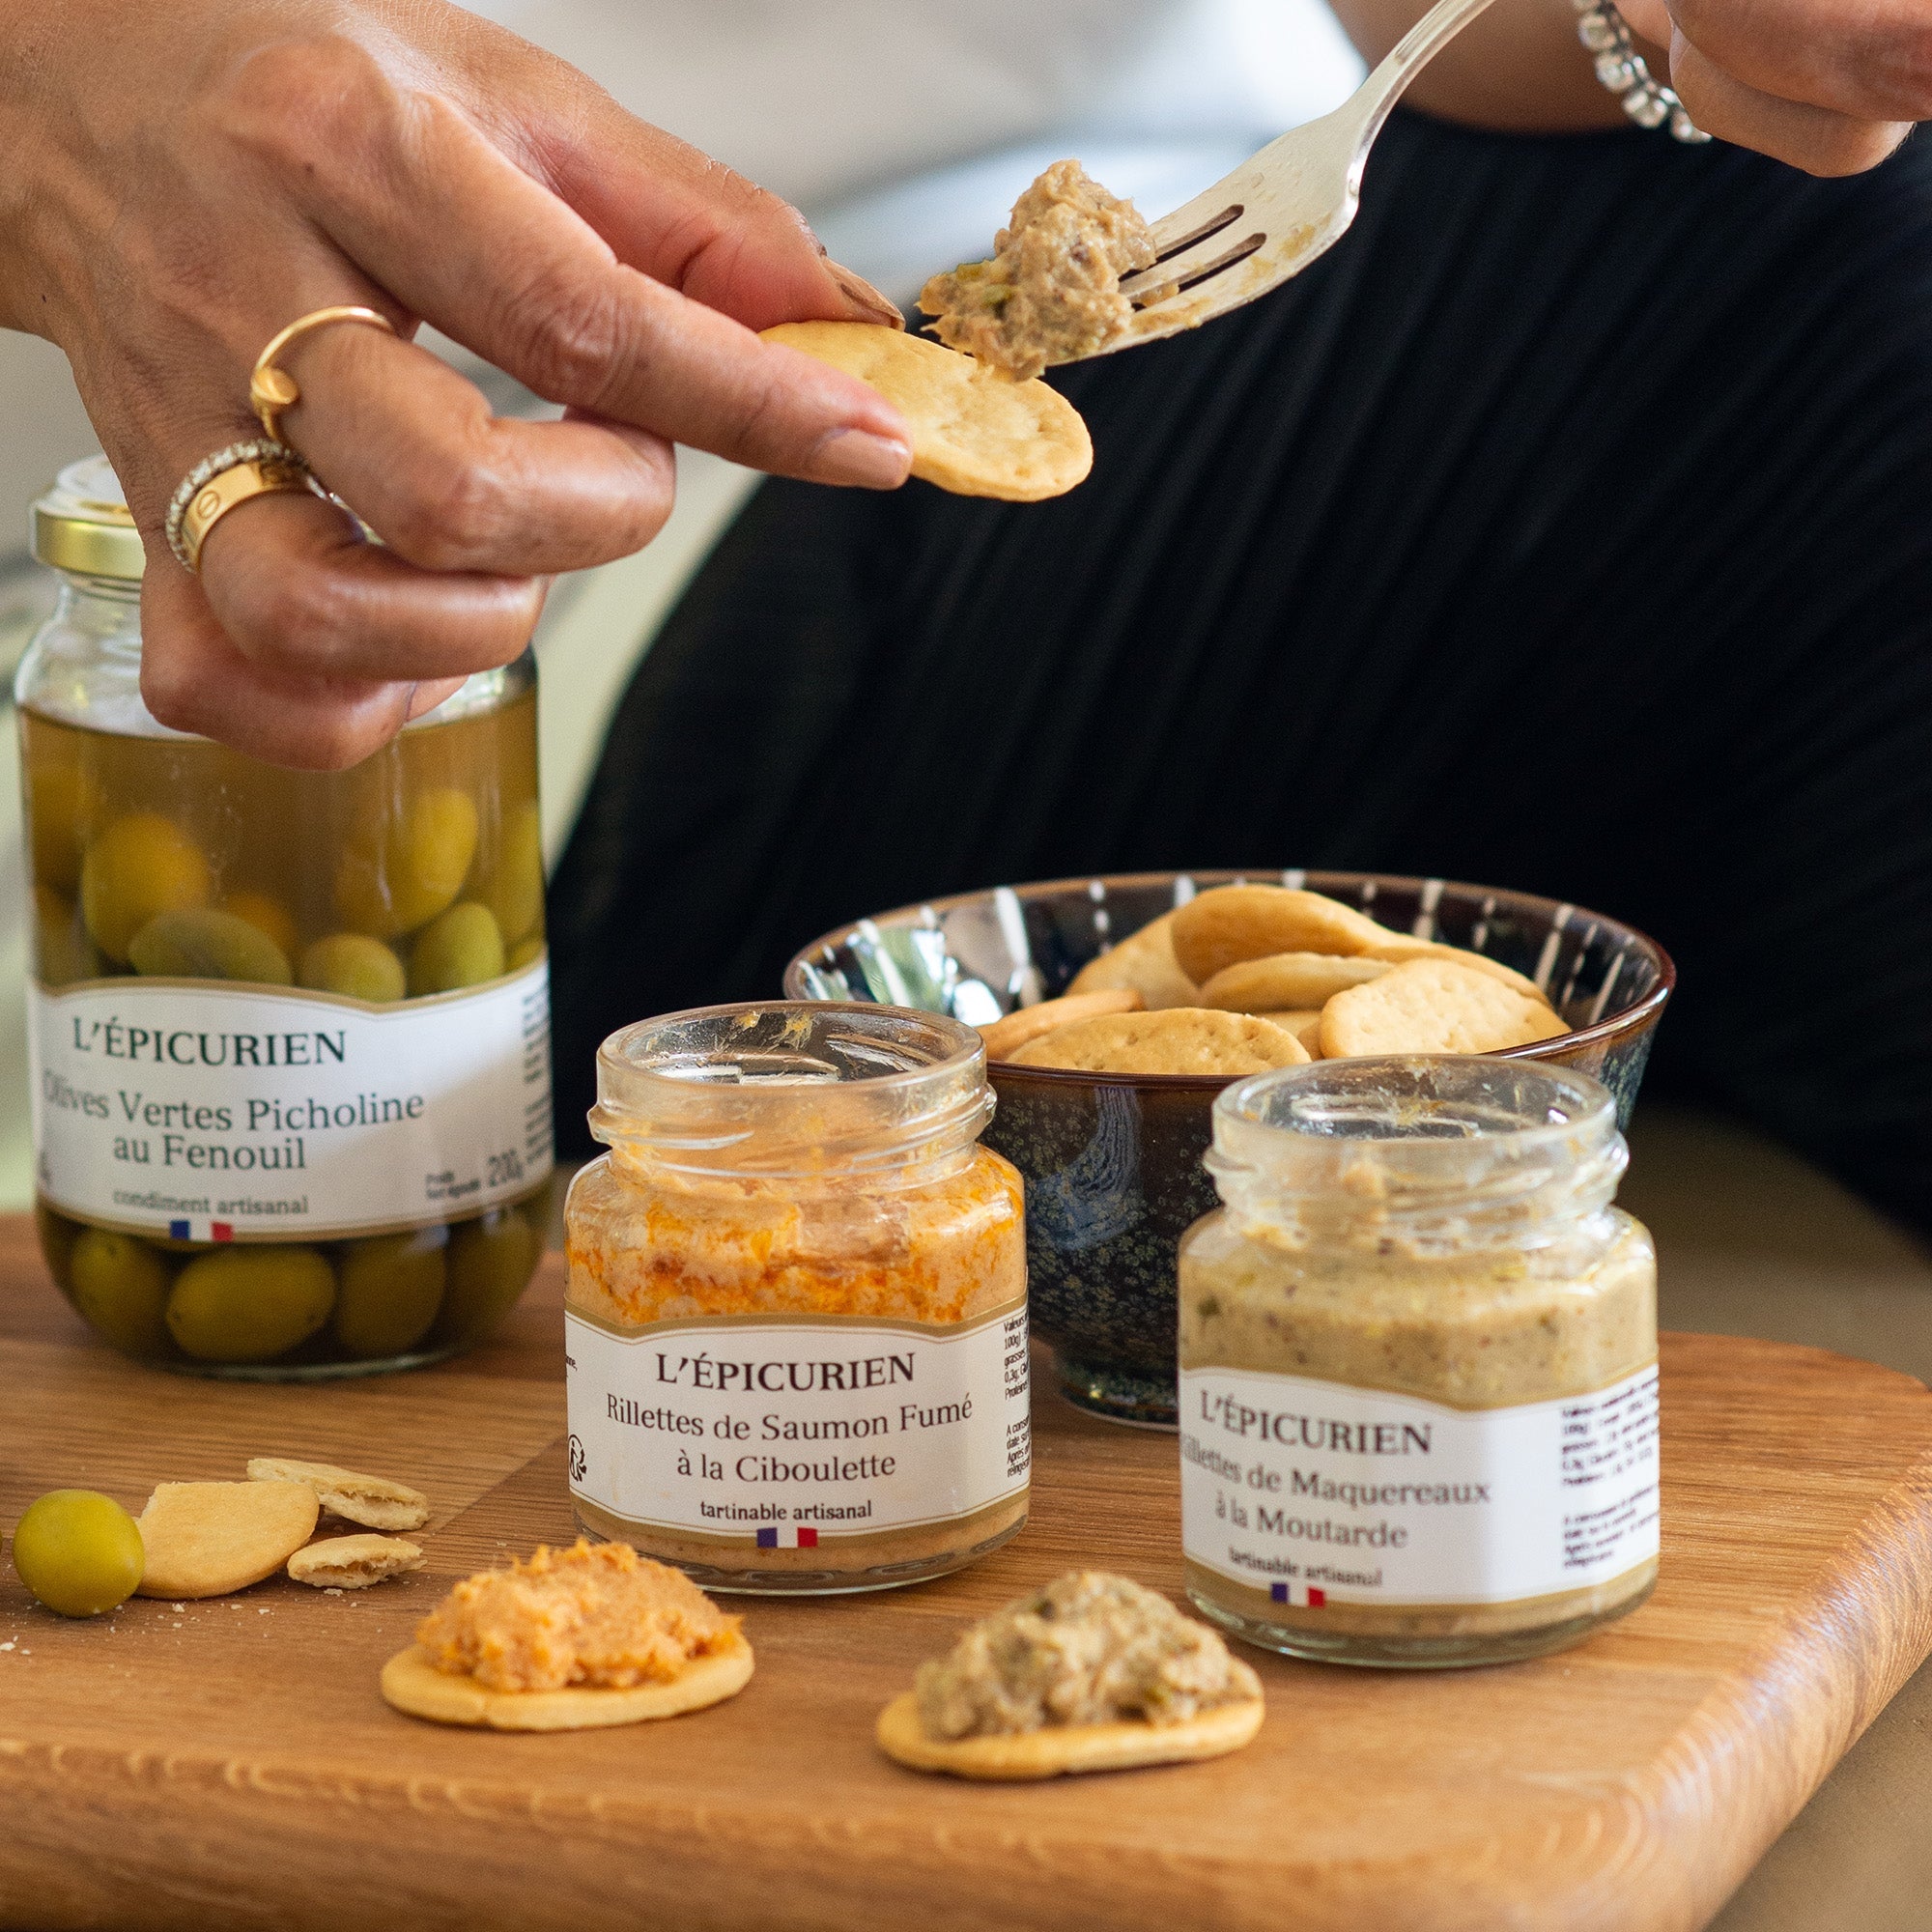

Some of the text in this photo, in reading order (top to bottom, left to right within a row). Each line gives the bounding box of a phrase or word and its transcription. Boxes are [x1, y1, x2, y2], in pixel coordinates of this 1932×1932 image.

[72, 1015, 346, 1066] L'ÉPICURIEN
[118, 1090, 233, 1131] Vertes
[246, 1093, 424, 1131] Picholine
[113, 1134, 306, 1171] au Fenouil
[112, 1189, 309, 1215] condiment artisanal
[655, 1351, 915, 1391] L'ÉPICURIEN
[607, 1392, 973, 1440] Rillettes de Saumon Fumé
[1200, 1389, 1433, 1455] L'ÉPICURIEN
[677, 1449, 896, 1482] à la Ciboulette
[1247, 1463, 1282, 1493] de
[1291, 1468, 1492, 1510] Maquereaux
[700, 1499, 872, 1520] tartinable artisanal
[1231, 1495, 1249, 1529] la
[1257, 1503, 1408, 1548] Moutarde
